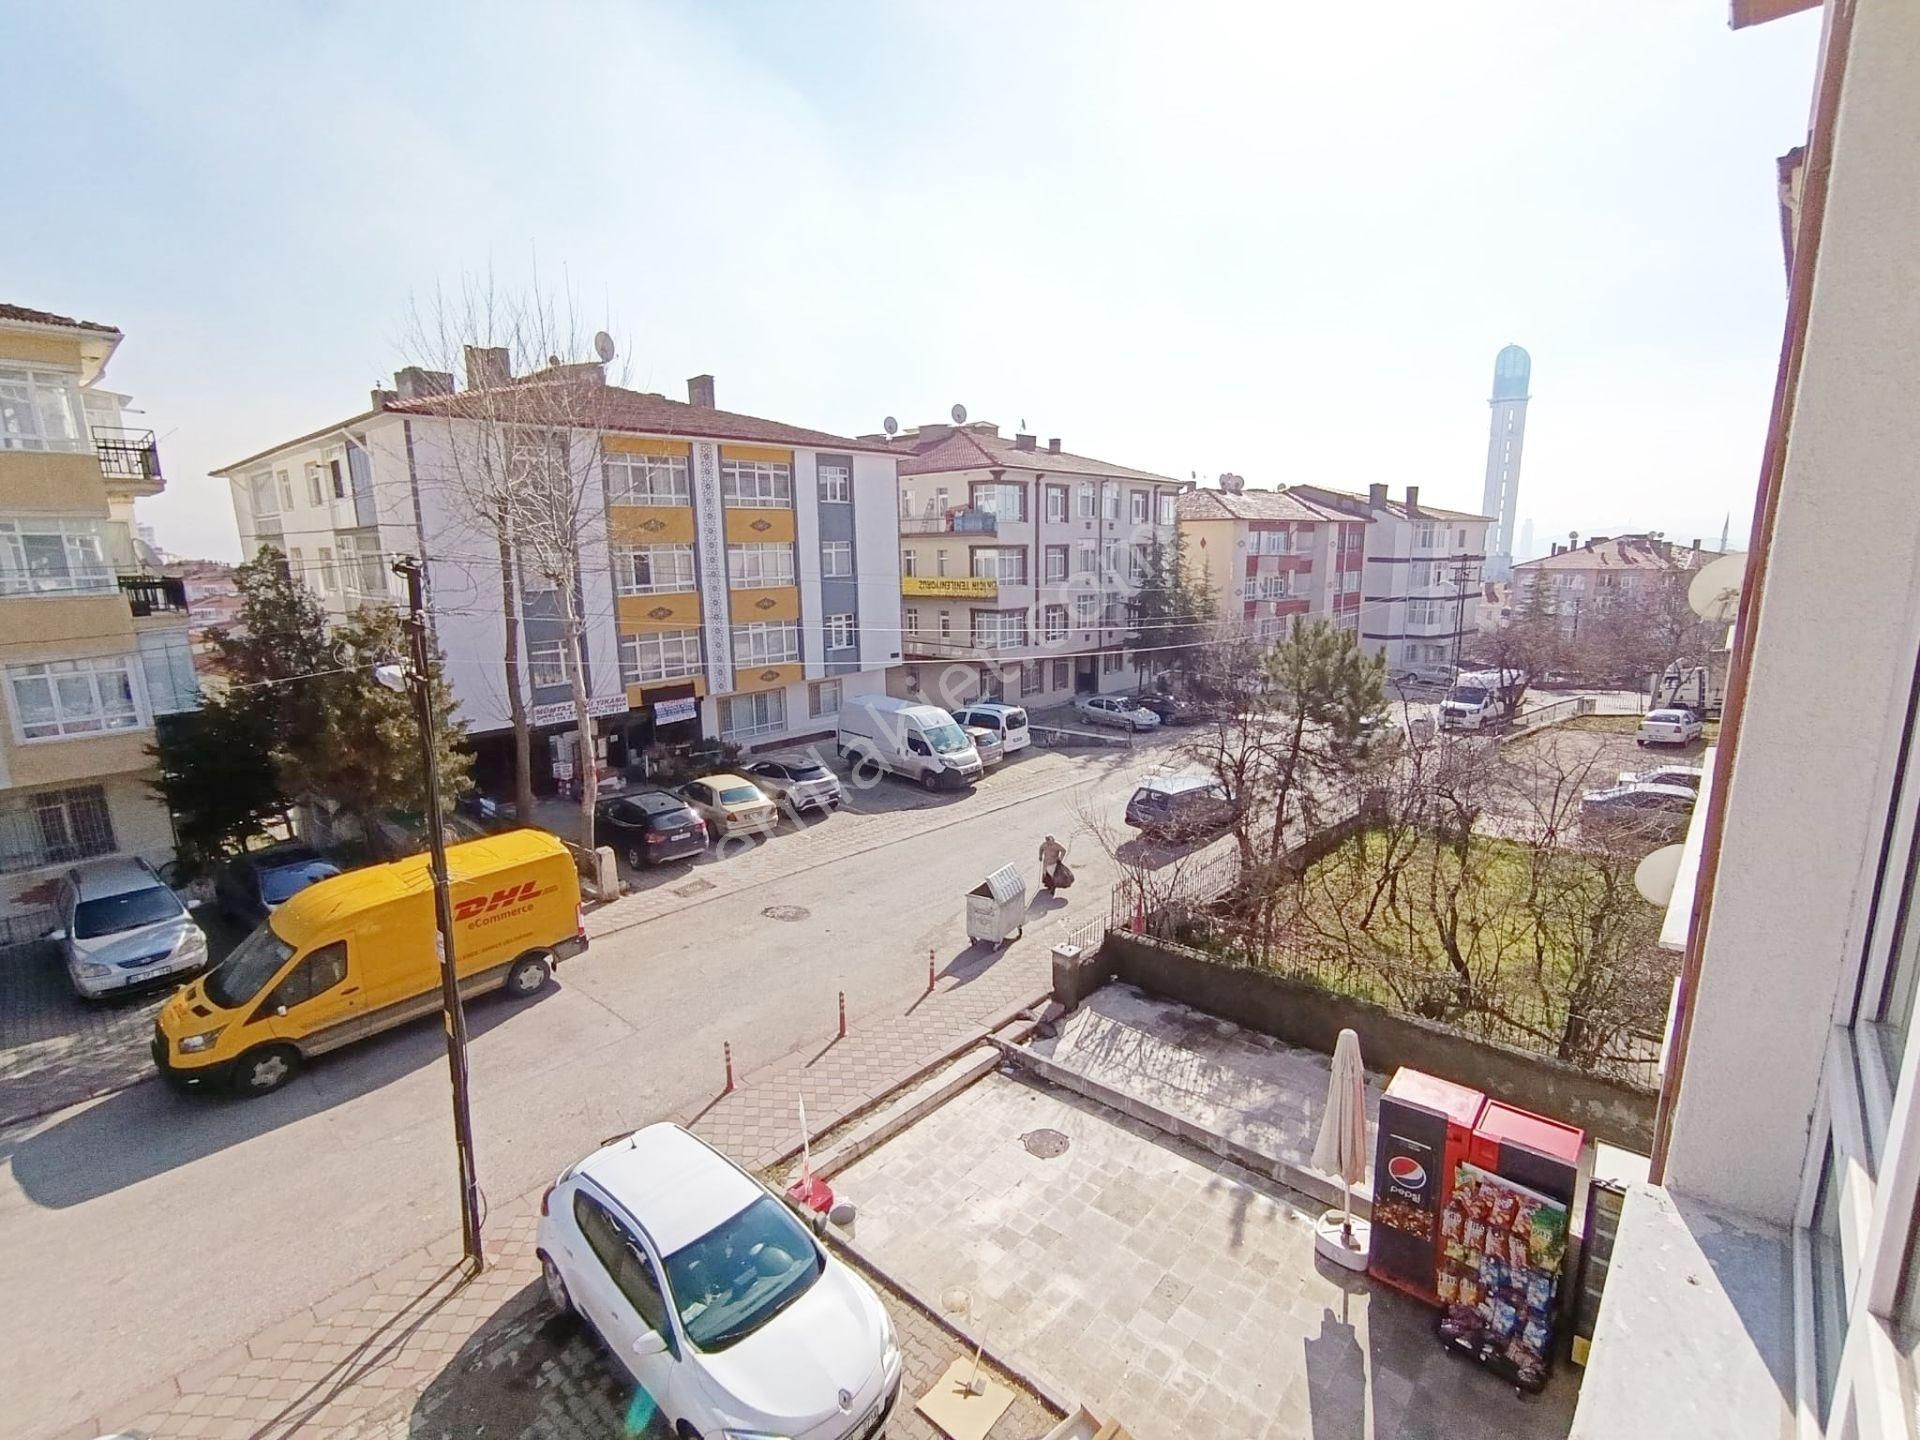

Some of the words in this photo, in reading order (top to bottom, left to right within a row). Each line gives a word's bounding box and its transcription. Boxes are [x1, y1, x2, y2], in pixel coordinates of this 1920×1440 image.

[454, 880, 543, 921] DHL
[467, 903, 534, 930] eCommerce
[1390, 1185, 1421, 1204] pepsi
